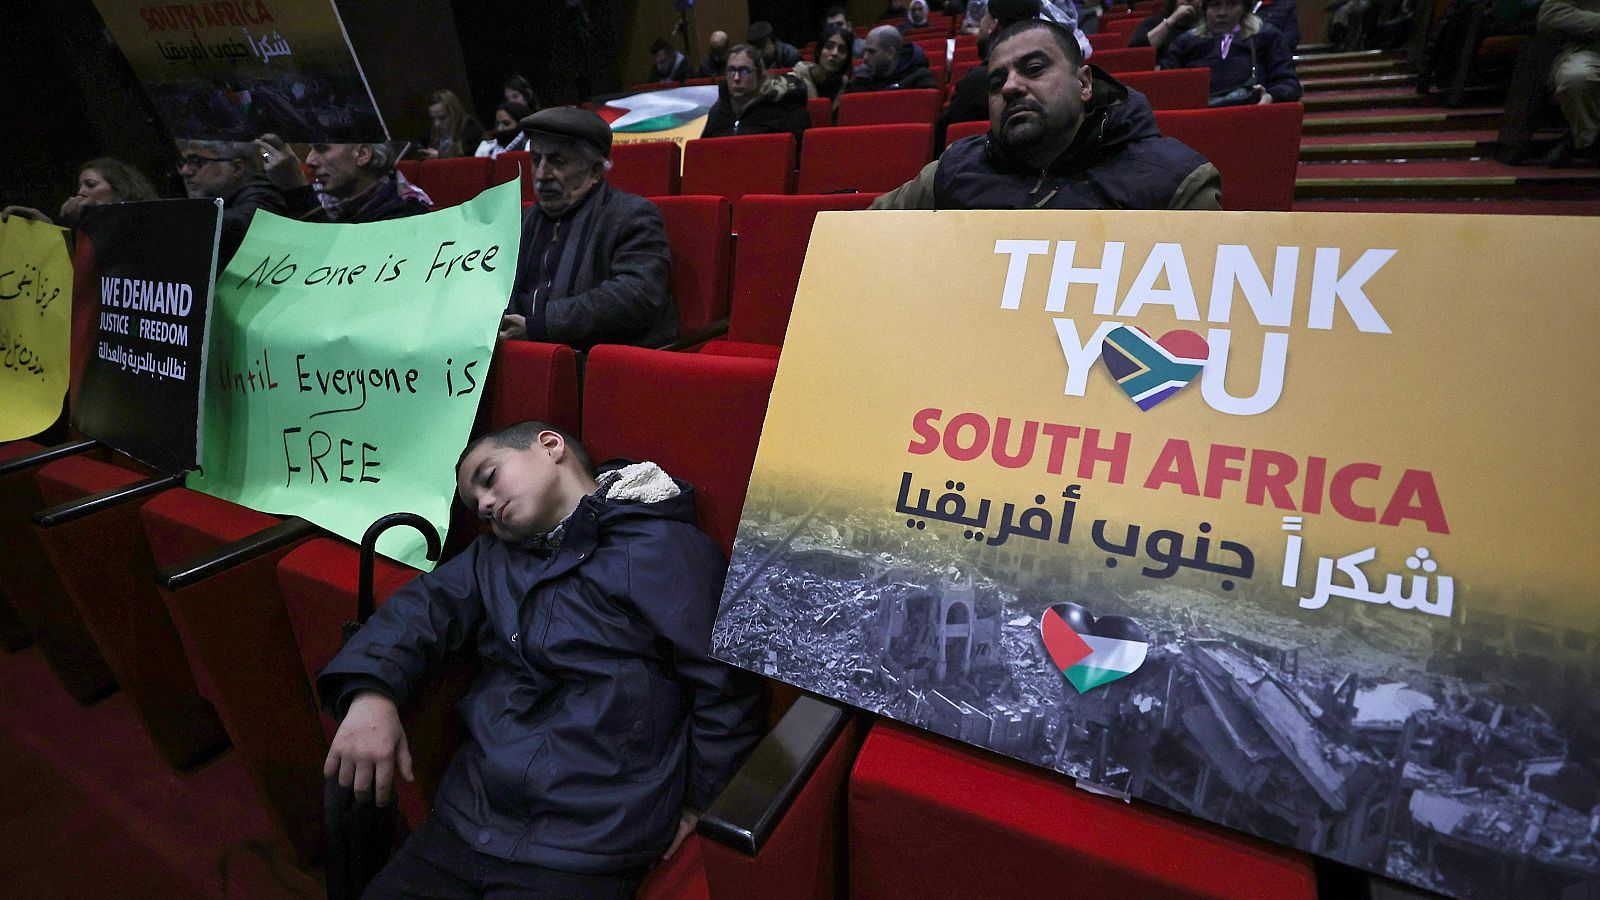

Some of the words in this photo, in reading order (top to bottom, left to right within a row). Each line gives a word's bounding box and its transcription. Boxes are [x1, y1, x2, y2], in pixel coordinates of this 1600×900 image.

[140, 4, 201, 30] SOUTH
[201, 0, 275, 26] AFRICA
[208, 36, 252, 62] جنوب
[242, 27, 292, 63] شكراً
[237, 254, 297, 290] No
[304, 264, 367, 287] one
[374, 254, 408, 284] is
[425, 241, 500, 284] Free
[994, 239, 1398, 334] THANK
[100, 276, 120, 307] WE
[122, 279, 193, 317] DEMAND
[99, 312, 129, 335] JUSTICE
[139, 321, 188, 347] FREEDOM
[98, 341, 128, 371] والعدالة
[127, 348, 157, 378] بالحرية
[157, 356, 187, 381] نطالب
[1052, 317, 1289, 416] YU
[296, 354, 419, 420] Everyone
[446, 357, 479, 398] is
[283, 427, 381, 489] FREE
[907, 407, 1132, 485] SOUTH
[1143, 438, 1451, 535] AFRICA
[895, 471, 1082, 547] أفريقيا
[1091, 520, 1256, 592] جنوب
[1281, 516, 1455, 618] شكراً
